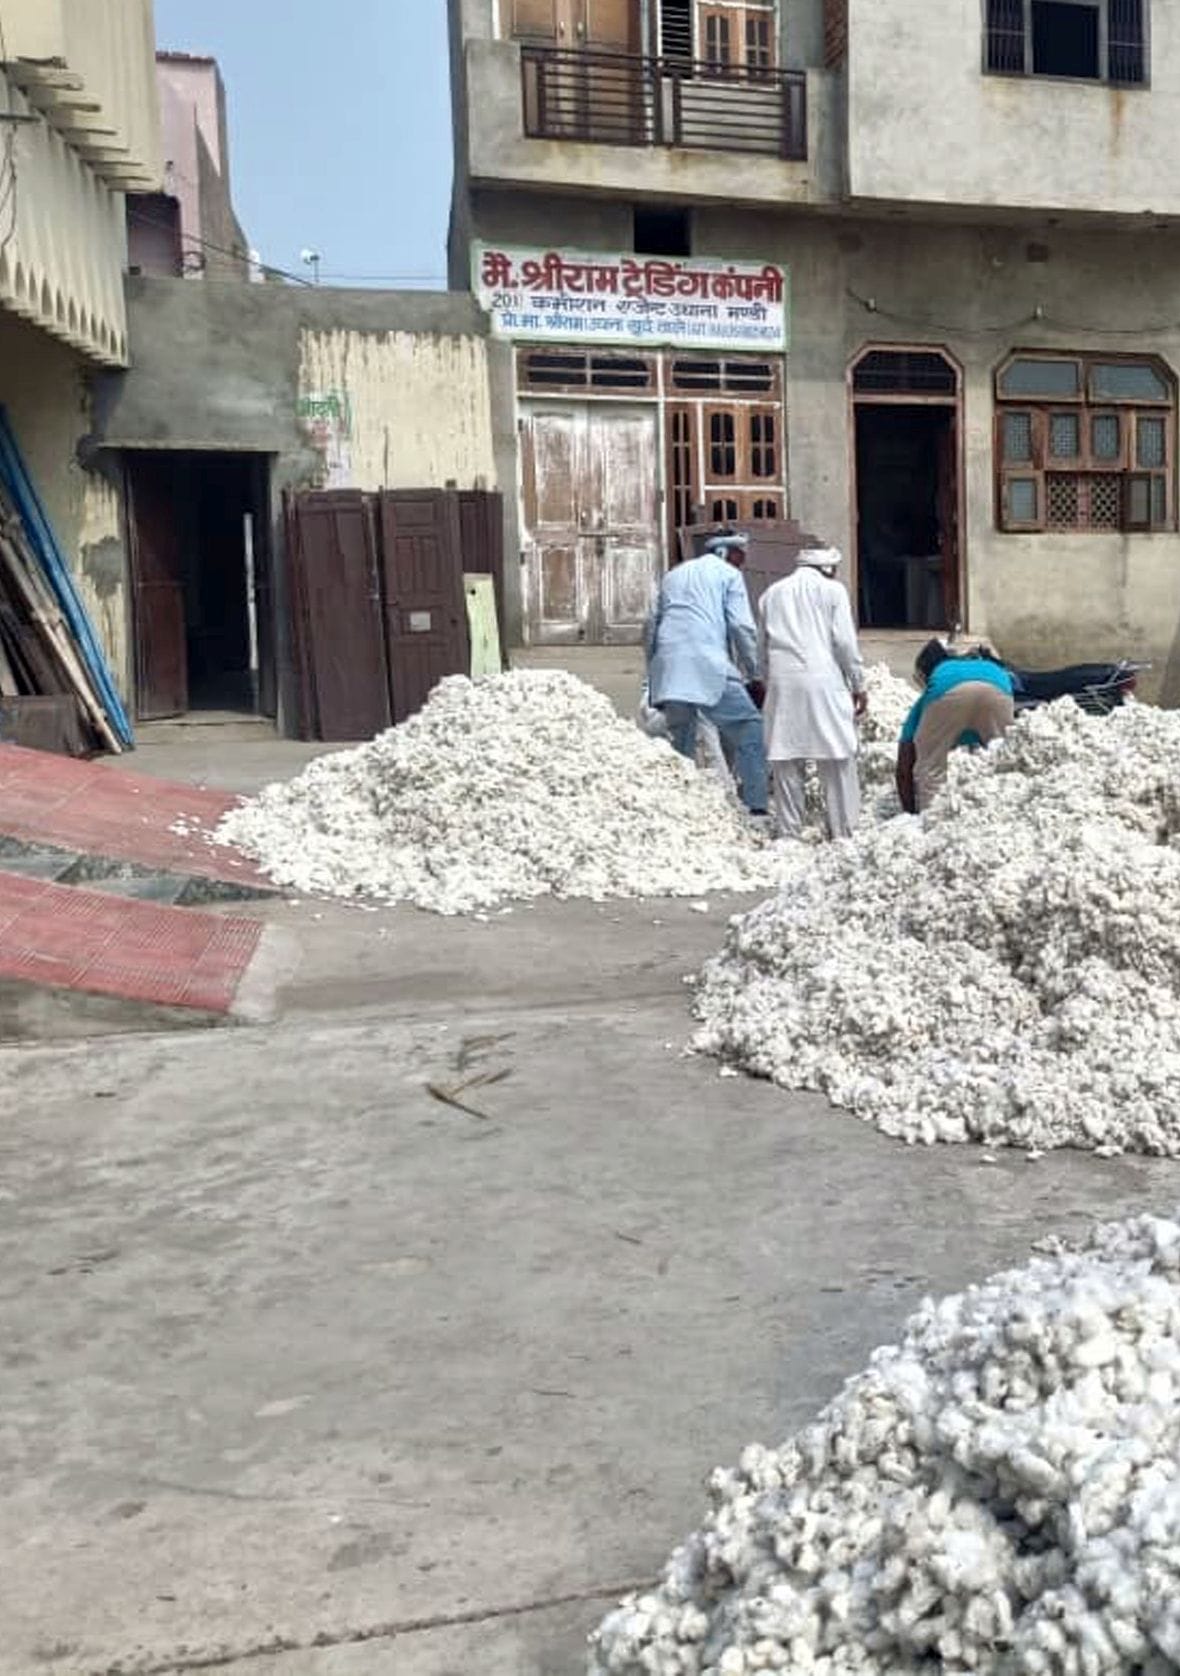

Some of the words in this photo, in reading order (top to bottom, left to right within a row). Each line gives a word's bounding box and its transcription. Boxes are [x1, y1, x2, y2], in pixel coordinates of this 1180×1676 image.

[521, 252, 619, 294] श्रीराम
[621, 257, 710, 298] ट्रेडिंग
[712, 265, 784, 303] कंपनी
